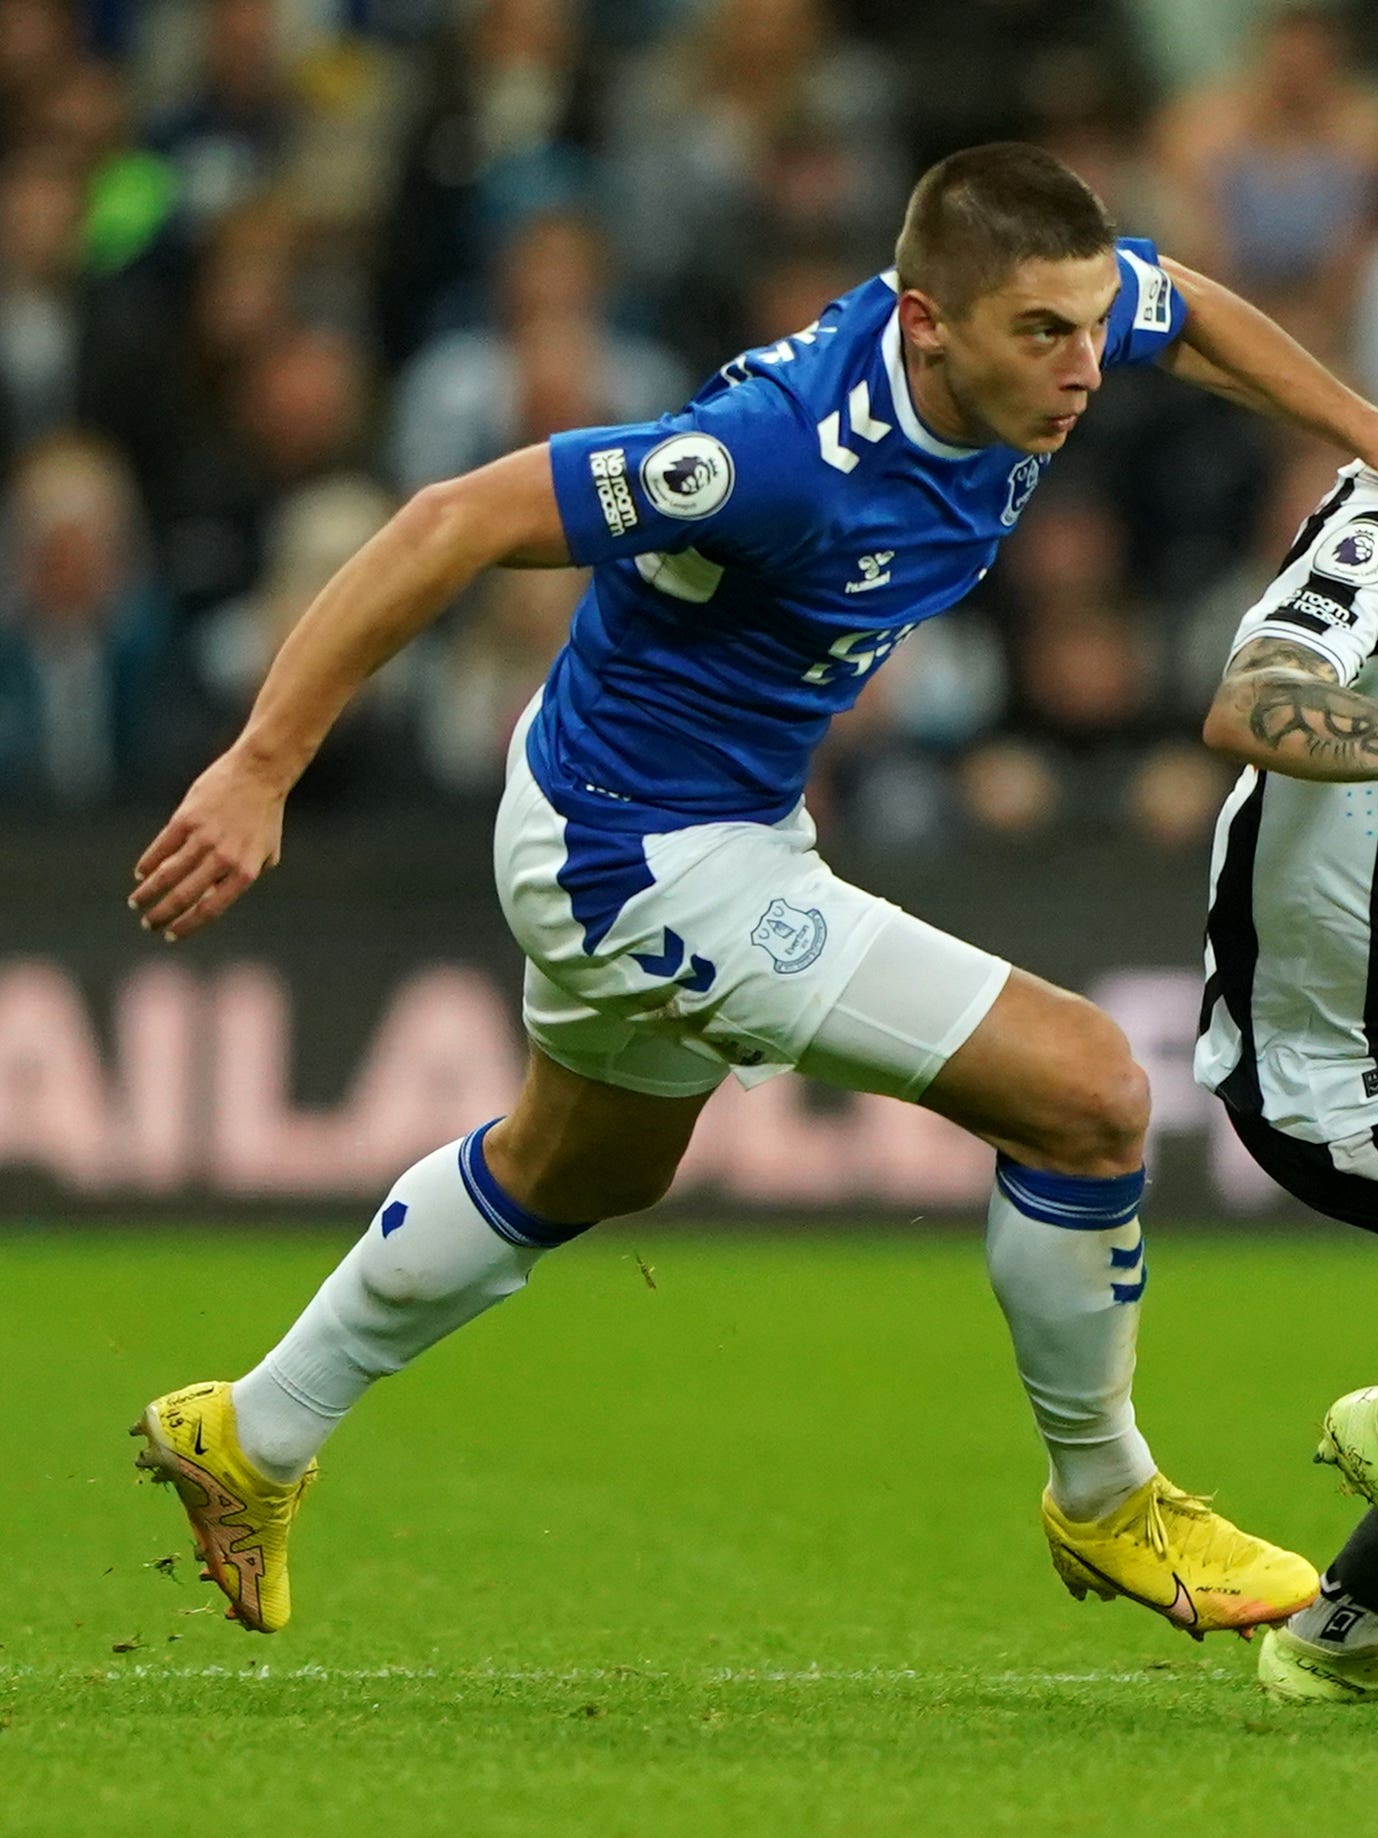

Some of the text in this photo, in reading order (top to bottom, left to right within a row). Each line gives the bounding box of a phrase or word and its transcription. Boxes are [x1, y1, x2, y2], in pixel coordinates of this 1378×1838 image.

[605, 448, 639, 528] No room
[1301, 590, 1351, 623] room
